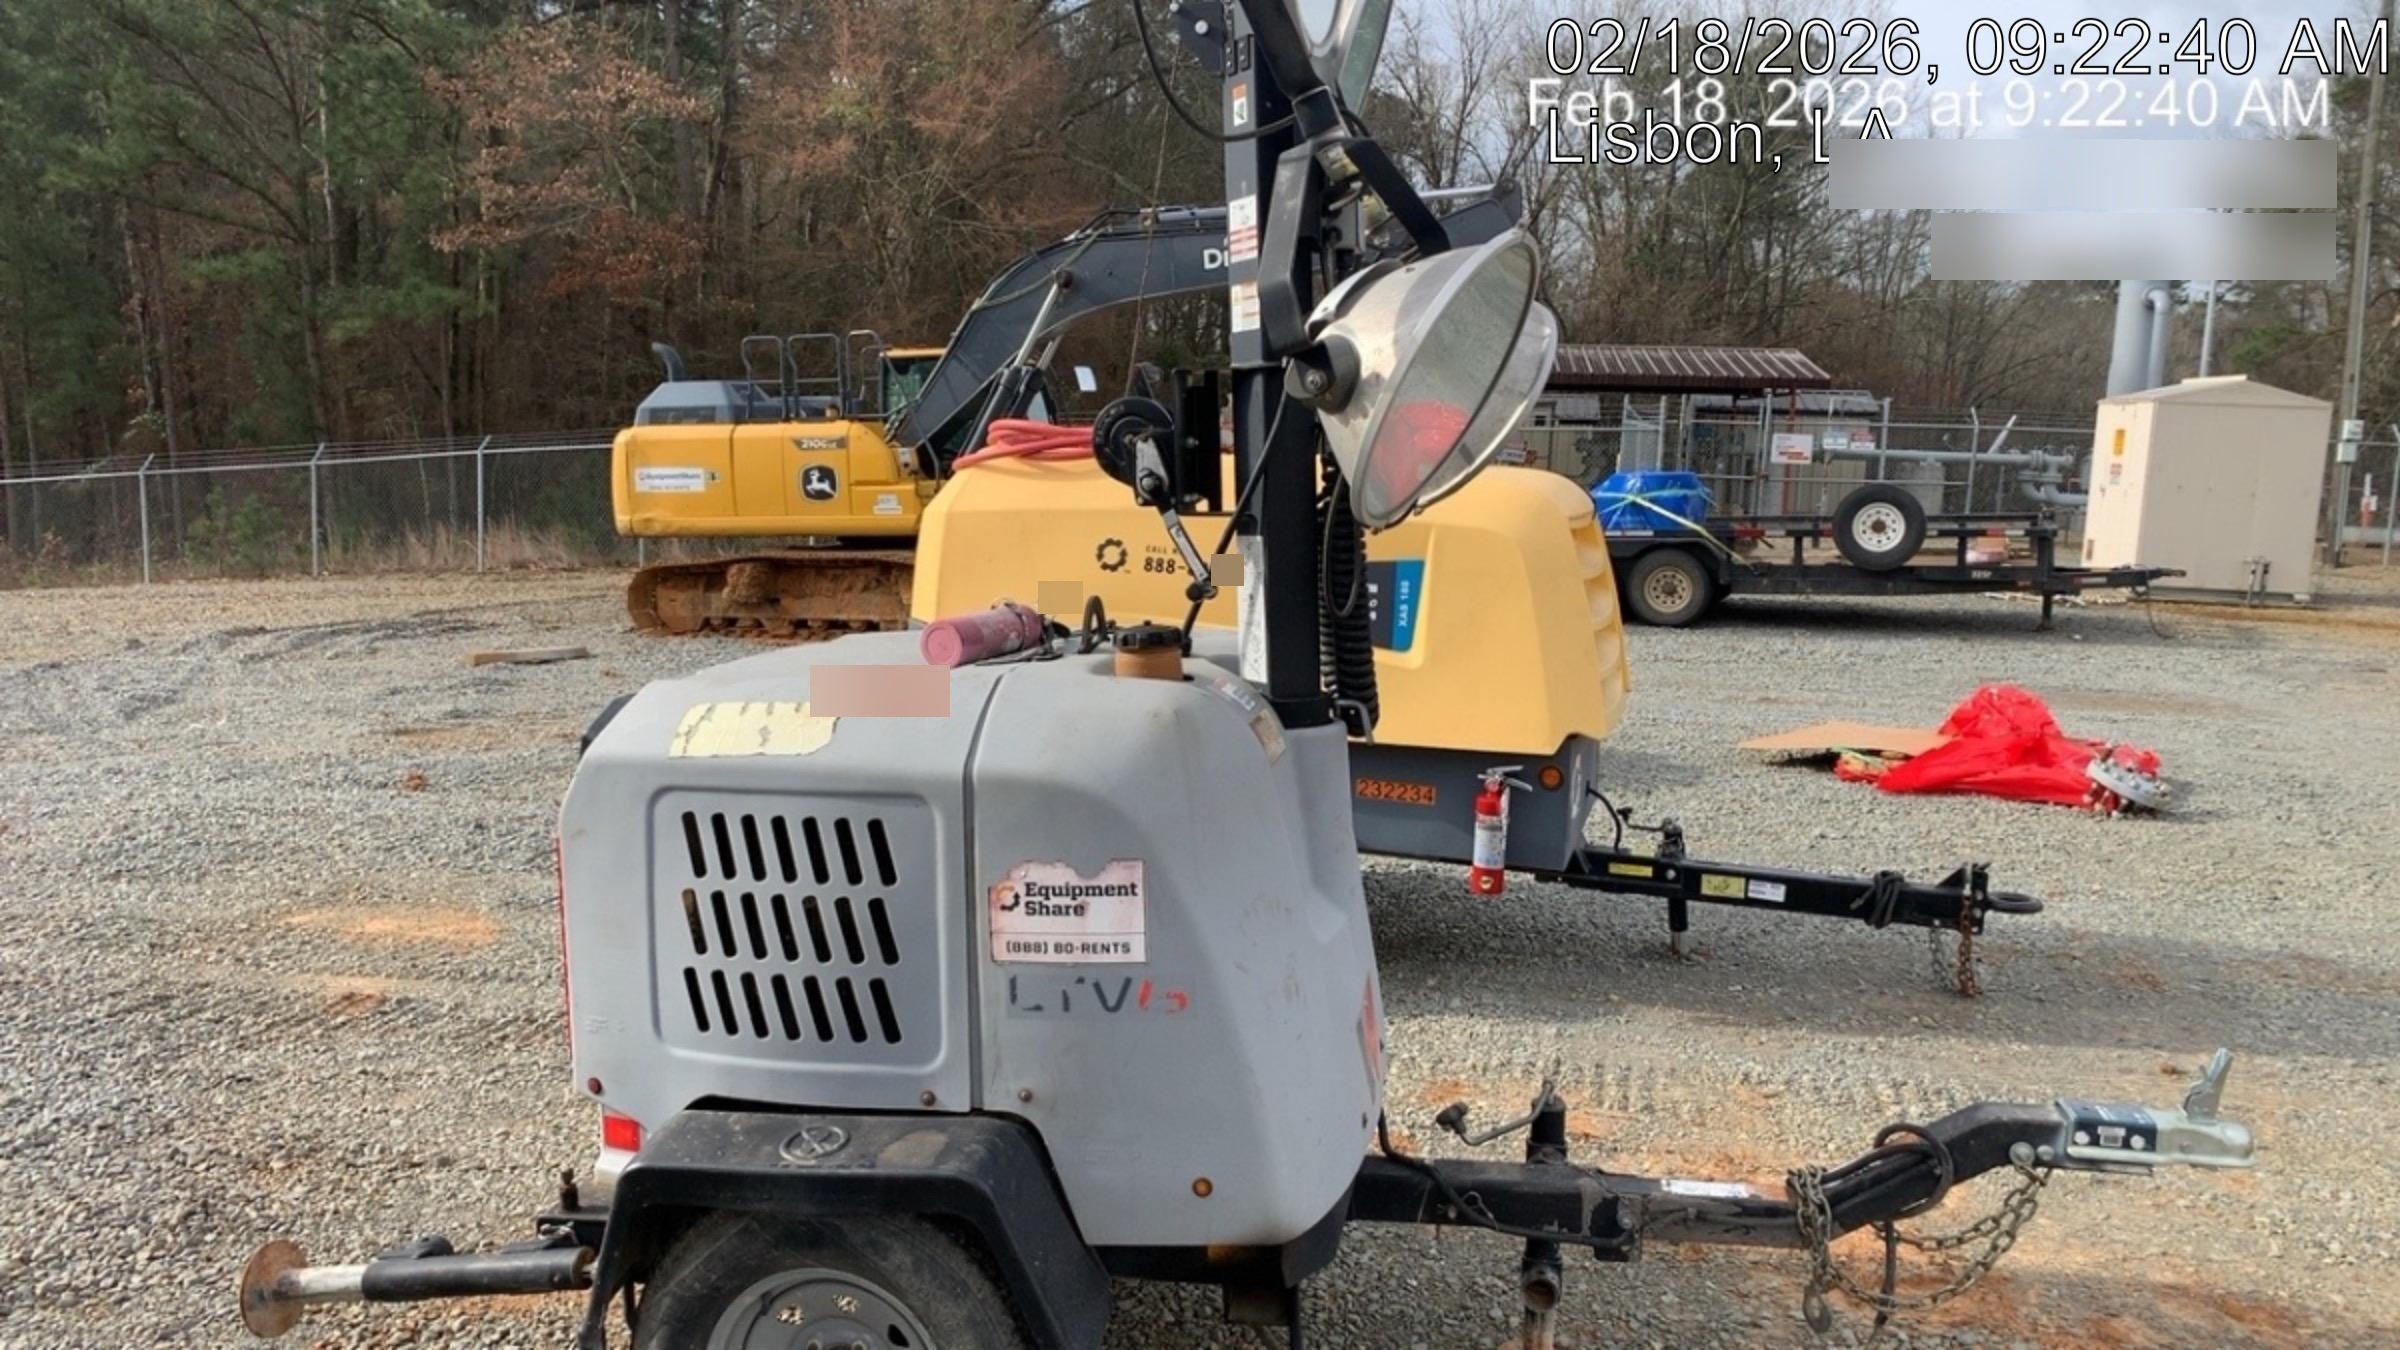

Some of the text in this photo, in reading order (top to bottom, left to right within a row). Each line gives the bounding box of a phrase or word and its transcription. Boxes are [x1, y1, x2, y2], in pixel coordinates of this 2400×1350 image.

[1358, 779, 1433, 802] 232234
[1024, 882, 1138, 900] Equipment
[1024, 901, 1085, 917] Share
[1006, 941, 1048, 955] (888)
